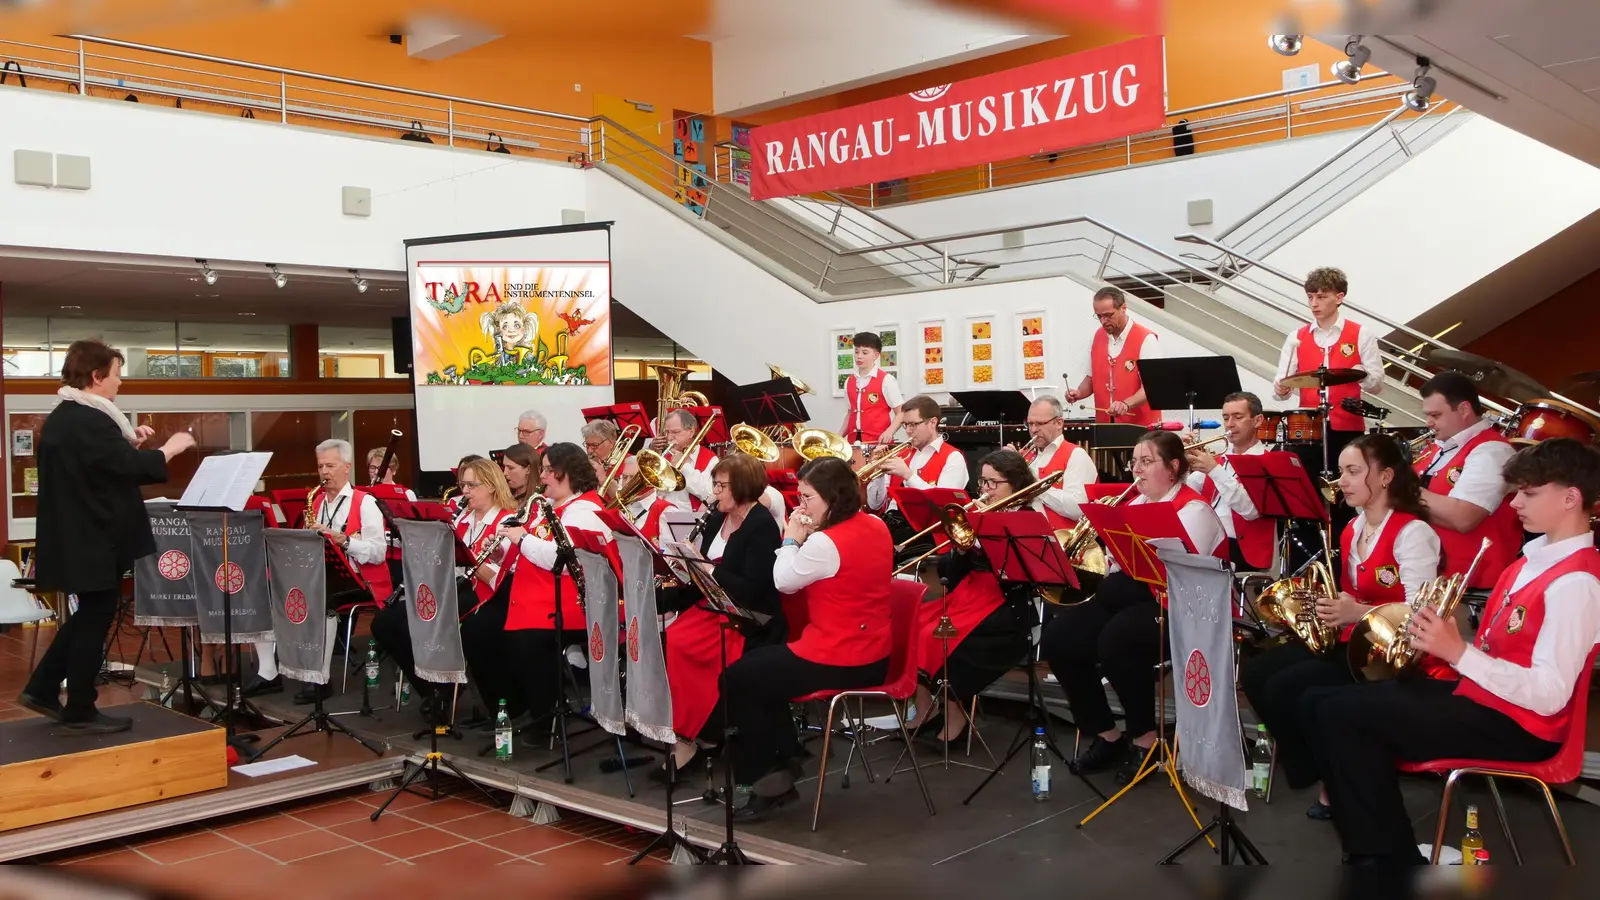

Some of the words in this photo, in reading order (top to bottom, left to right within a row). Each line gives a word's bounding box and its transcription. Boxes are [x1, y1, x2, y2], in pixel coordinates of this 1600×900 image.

[503, 283, 523, 291] UND
[524, 283, 540, 291] DIE
[425, 281, 501, 304] TARA
[503, 290, 596, 298] INSTRUMENTENINSEL
[150, 517, 188, 527] RANGA
[151, 527, 192, 536] USIKZU
[203, 535, 251, 547] MUSKZUG
[150, 593, 172, 601] MARKT
[173, 593, 198, 601] ERLBA
[208, 608, 226, 618] MARK
